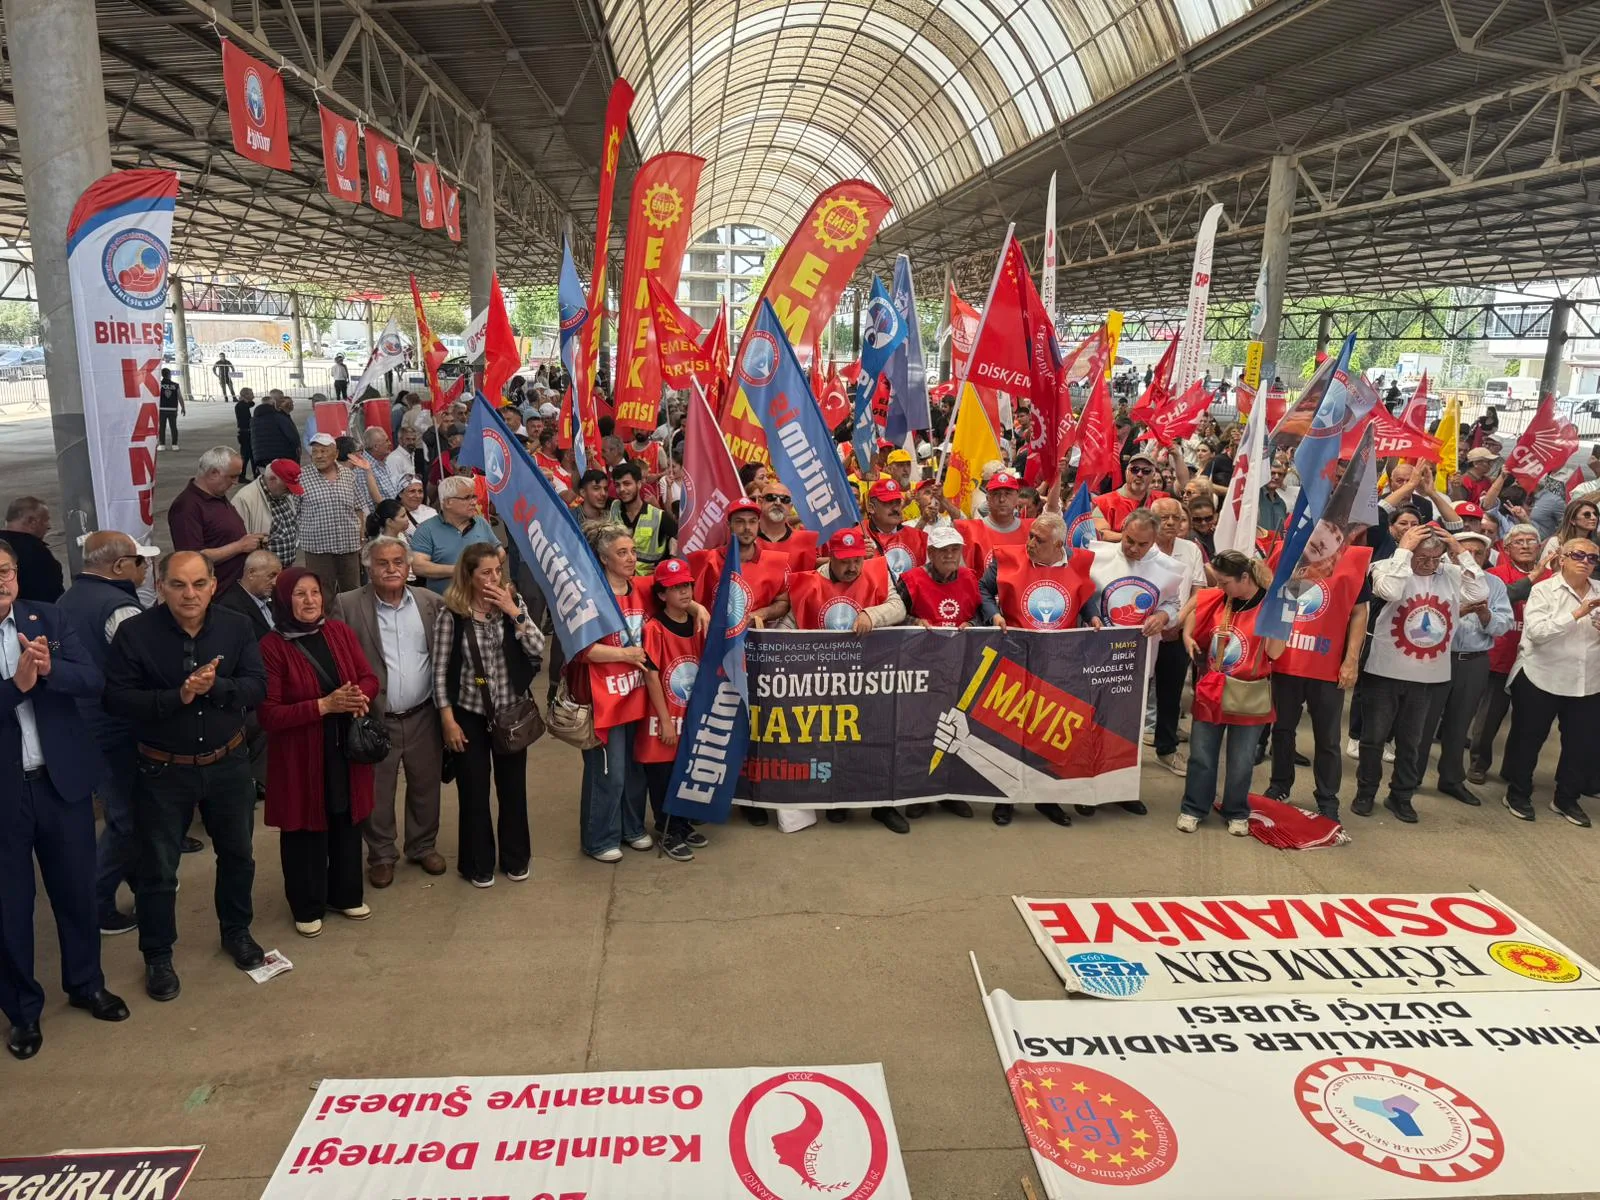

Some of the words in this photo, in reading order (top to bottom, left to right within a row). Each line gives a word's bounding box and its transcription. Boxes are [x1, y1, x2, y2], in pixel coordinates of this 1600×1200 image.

[650, 200, 676, 214] EMEP
[825, 213, 857, 234] EMEP
[661, 358, 711, 377] ARTİSİ
[1512, 445, 1545, 479] CHP
[757, 641, 811, 652] SENDİKASIZ
[812, 641, 862, 651] ÇALIŞMAYA
[784, 652, 816, 663] ÇOCUK
[817, 651, 862, 662] İŞÇİLİĞİNE
[1110, 642, 1114, 650] 1
[1115, 641, 1137, 649] MAYIS
[1112, 651, 1136, 661] BİRLİK
[757, 664, 930, 699] SÖMÜRÜSÜNE
[1082, 664, 1124, 675] MÜCADELE
[1124, 663, 1134, 671] VE
[1091, 674, 1133, 686] DAYANIŞMA
[956, 645, 998, 712] 1
[982, 671, 1085, 751] MAYIS
[1111, 685, 1132, 694] GÜNÜ
[1027, 896, 1517, 947] OSMANİYE
[1155, 949, 1272, 984] SEN
[1261, 945, 1492, 988] EĞİTİM
[1177, 998, 1320, 1029] ŞUBESİ
[1326, 997, 1472, 1026] DÜZİÇİ
[1245, 1028, 1474, 1056] EMEKLİLER
[787, 1073, 813, 1081] 2020
[315, 1085, 472, 1121] Şubesi
[487, 1084, 704, 1115] Osmaniye
[1145, 1108, 1172, 1157] Fédération
[288, 1137, 479, 1174] Derneği
[495, 1133, 701, 1164] Kadınları
[810, 1140, 823, 1152] 29
[805, 1151, 817, 1176] Ekim
[1063, 1159, 1087, 1174] des
[1091, 1156, 1166, 1180] Européenne
